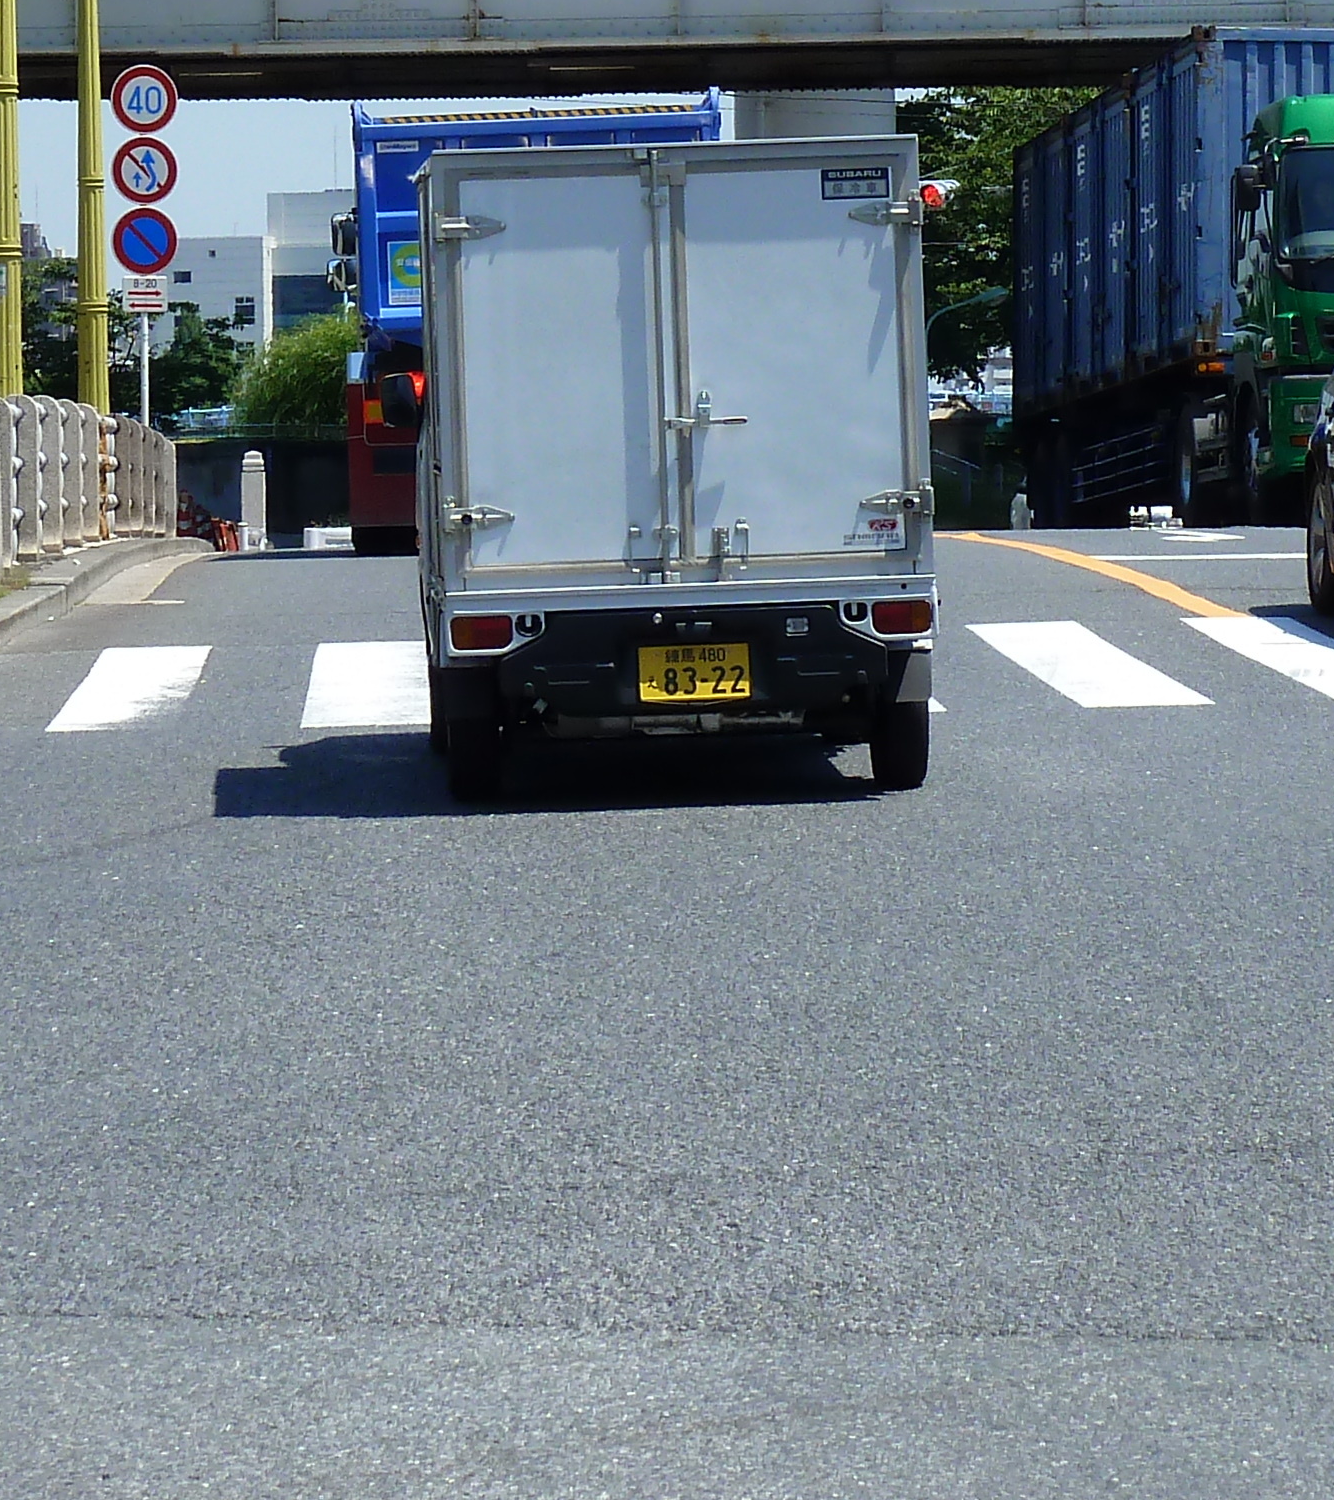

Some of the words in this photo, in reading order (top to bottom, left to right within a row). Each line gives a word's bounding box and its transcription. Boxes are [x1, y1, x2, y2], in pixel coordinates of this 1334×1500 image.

[128, 86, 161, 114] 40
[828, 170, 881, 178] SUBARU
[133, 278, 158, 288] 8-20
[699, 648, 726, 662] 480
[664, 665, 746, 695] 83-22
